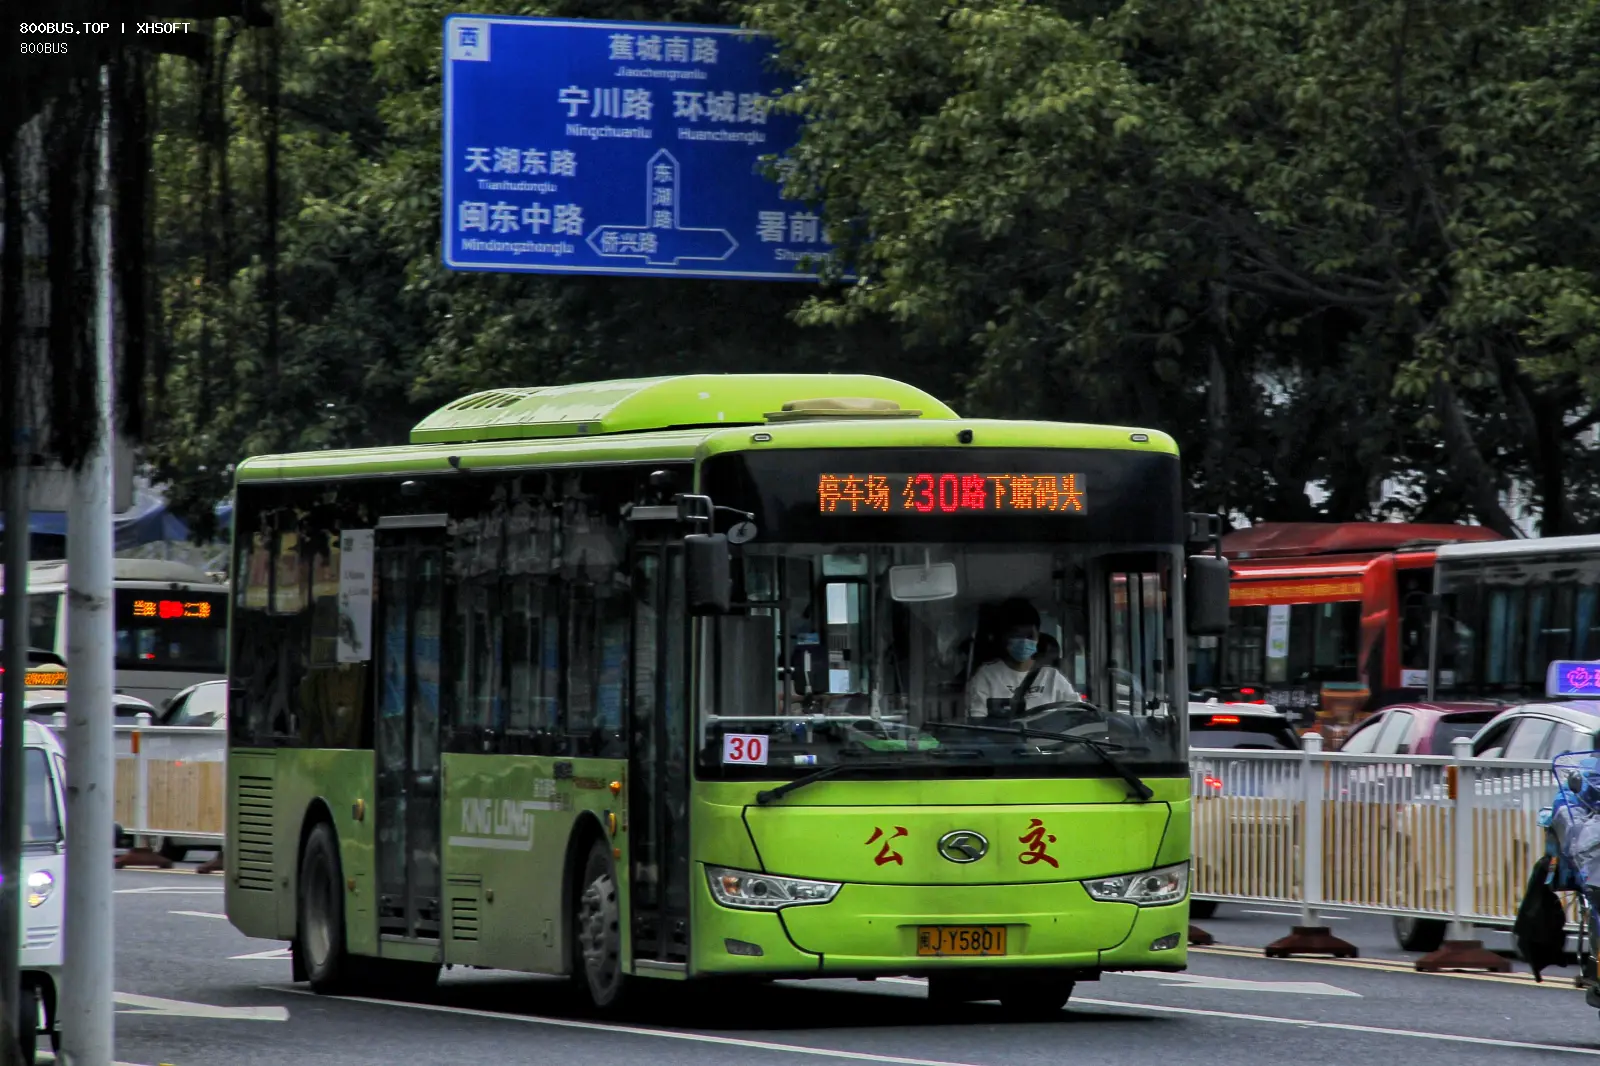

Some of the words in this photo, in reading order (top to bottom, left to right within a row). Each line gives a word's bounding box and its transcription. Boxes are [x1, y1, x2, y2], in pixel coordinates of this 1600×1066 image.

[457, 27, 480, 47] 西
[608, 33, 719, 64] 蕉城南路
[558, 85, 654, 120] 宁川路
[672, 91, 769, 124] 环城路
[464, 147, 577, 176] 天湖东路
[653, 163, 673, 229] 东湖路
[458, 200, 585, 236] 闽东中路
[818, 474, 890, 512] 停车场
[729, 737, 762, 761] 30
[462, 798, 492, 834] KING
[494, 800, 531, 836] LONG
[864, 826, 908, 866] 公
[1018, 818, 1059, 868] 交
